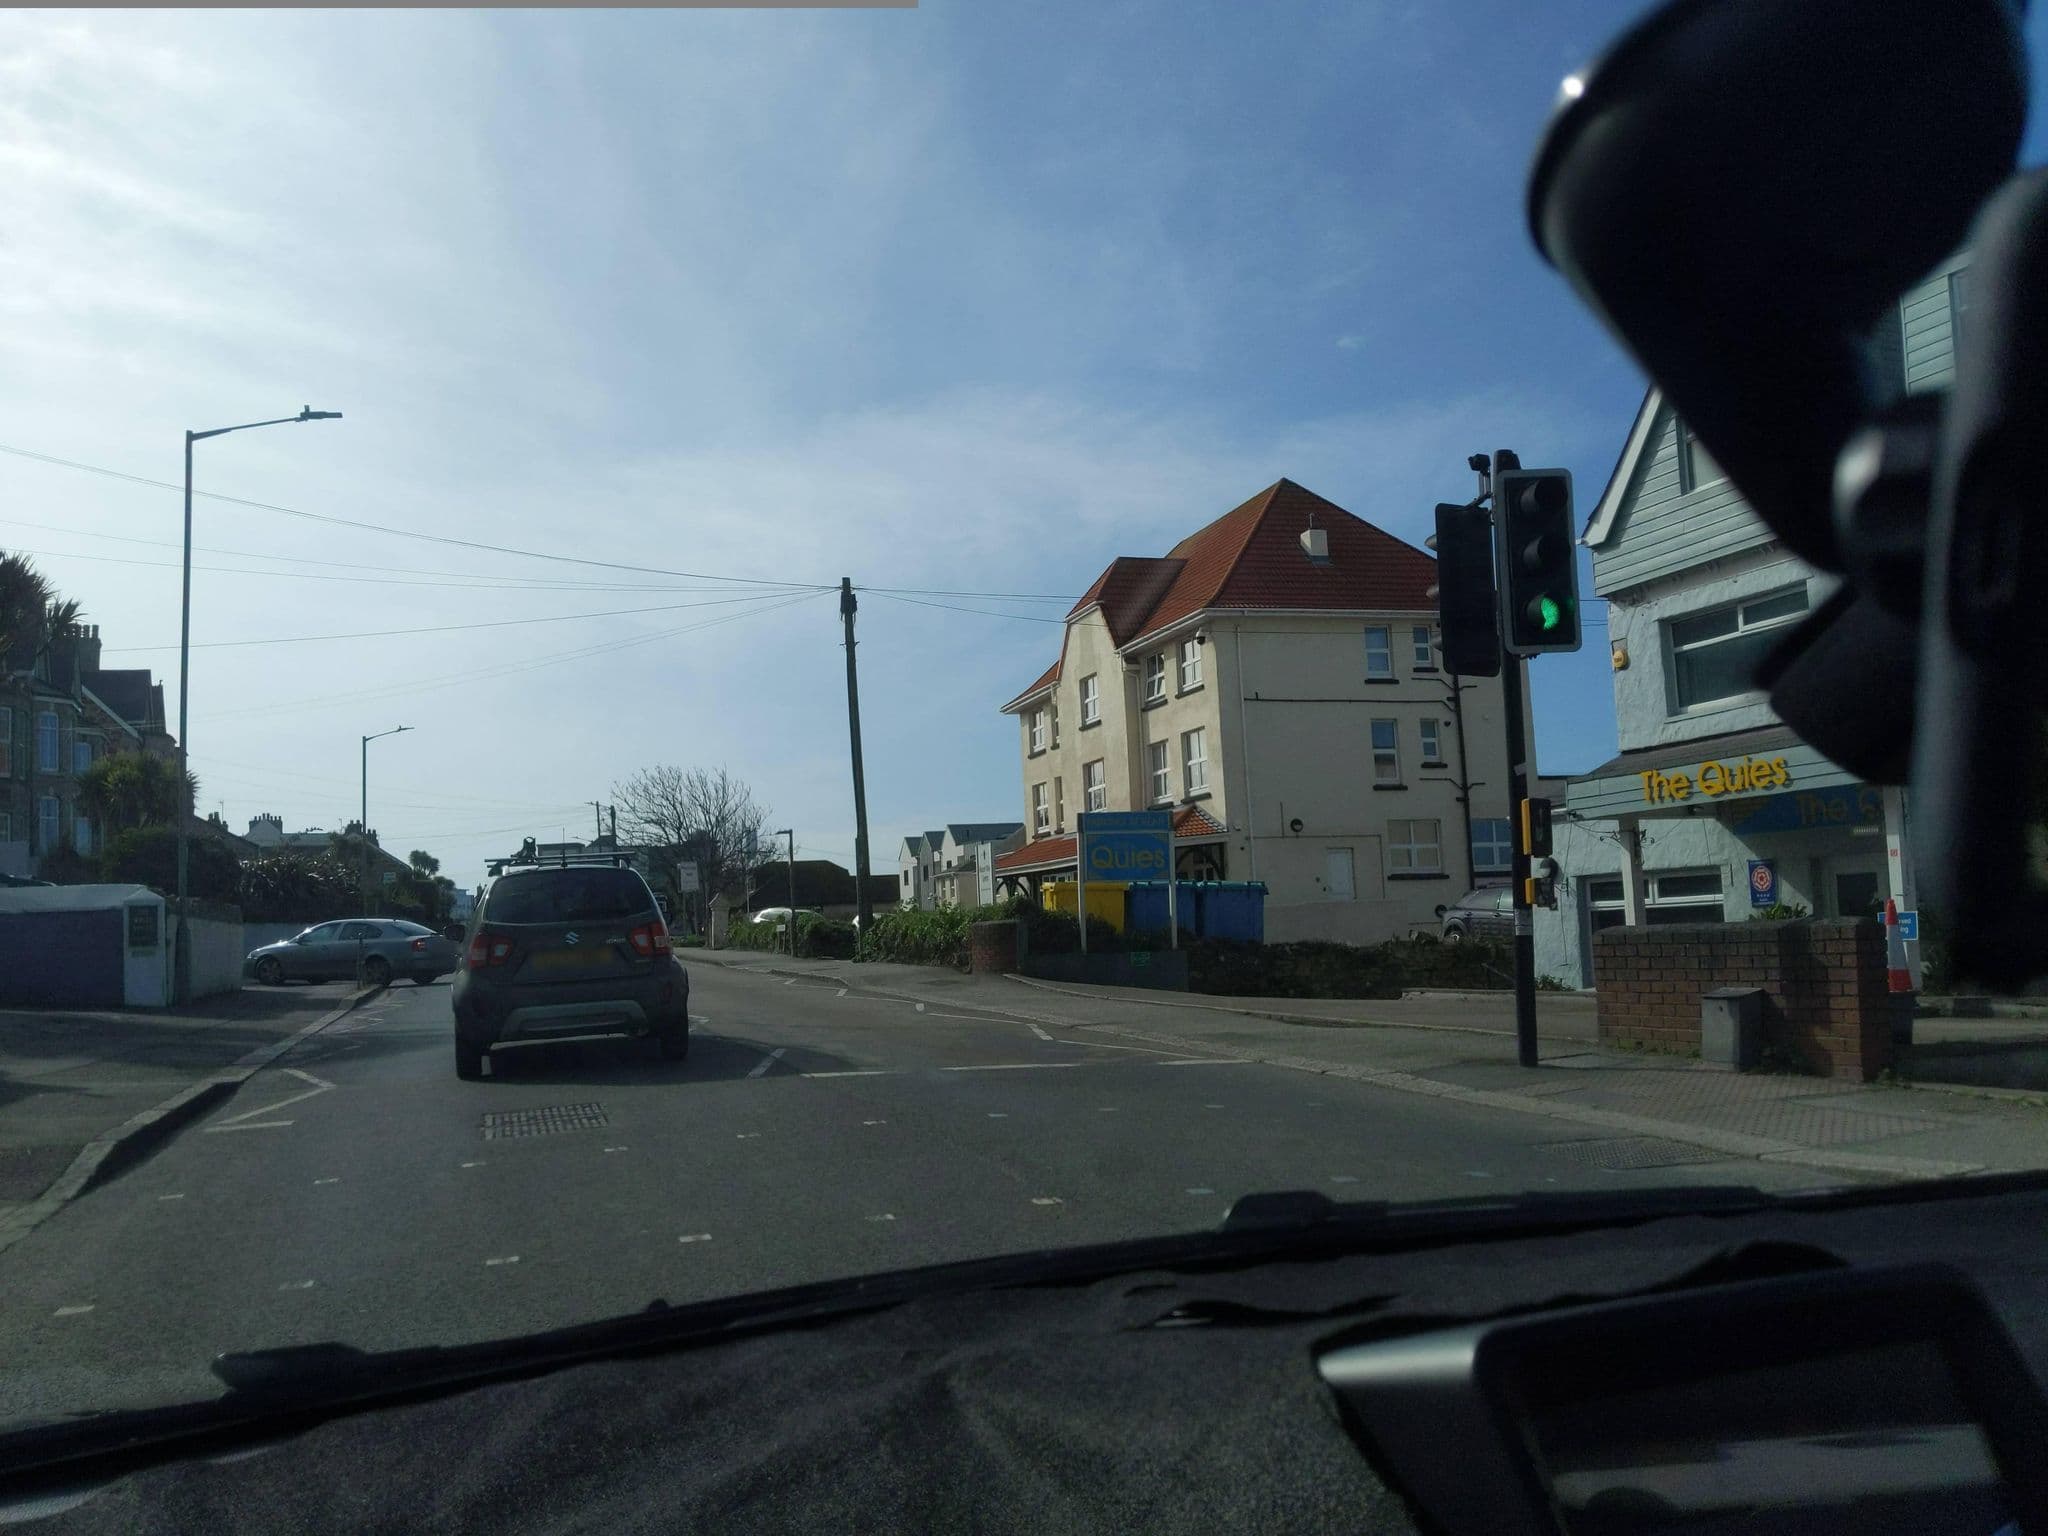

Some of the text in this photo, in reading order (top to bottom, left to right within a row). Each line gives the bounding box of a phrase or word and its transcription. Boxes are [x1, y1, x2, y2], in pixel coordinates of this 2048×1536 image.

[1640, 755, 1787, 801] The Quies
[1798, 796, 1848, 824] The
[1091, 845, 1165, 869] Quies
